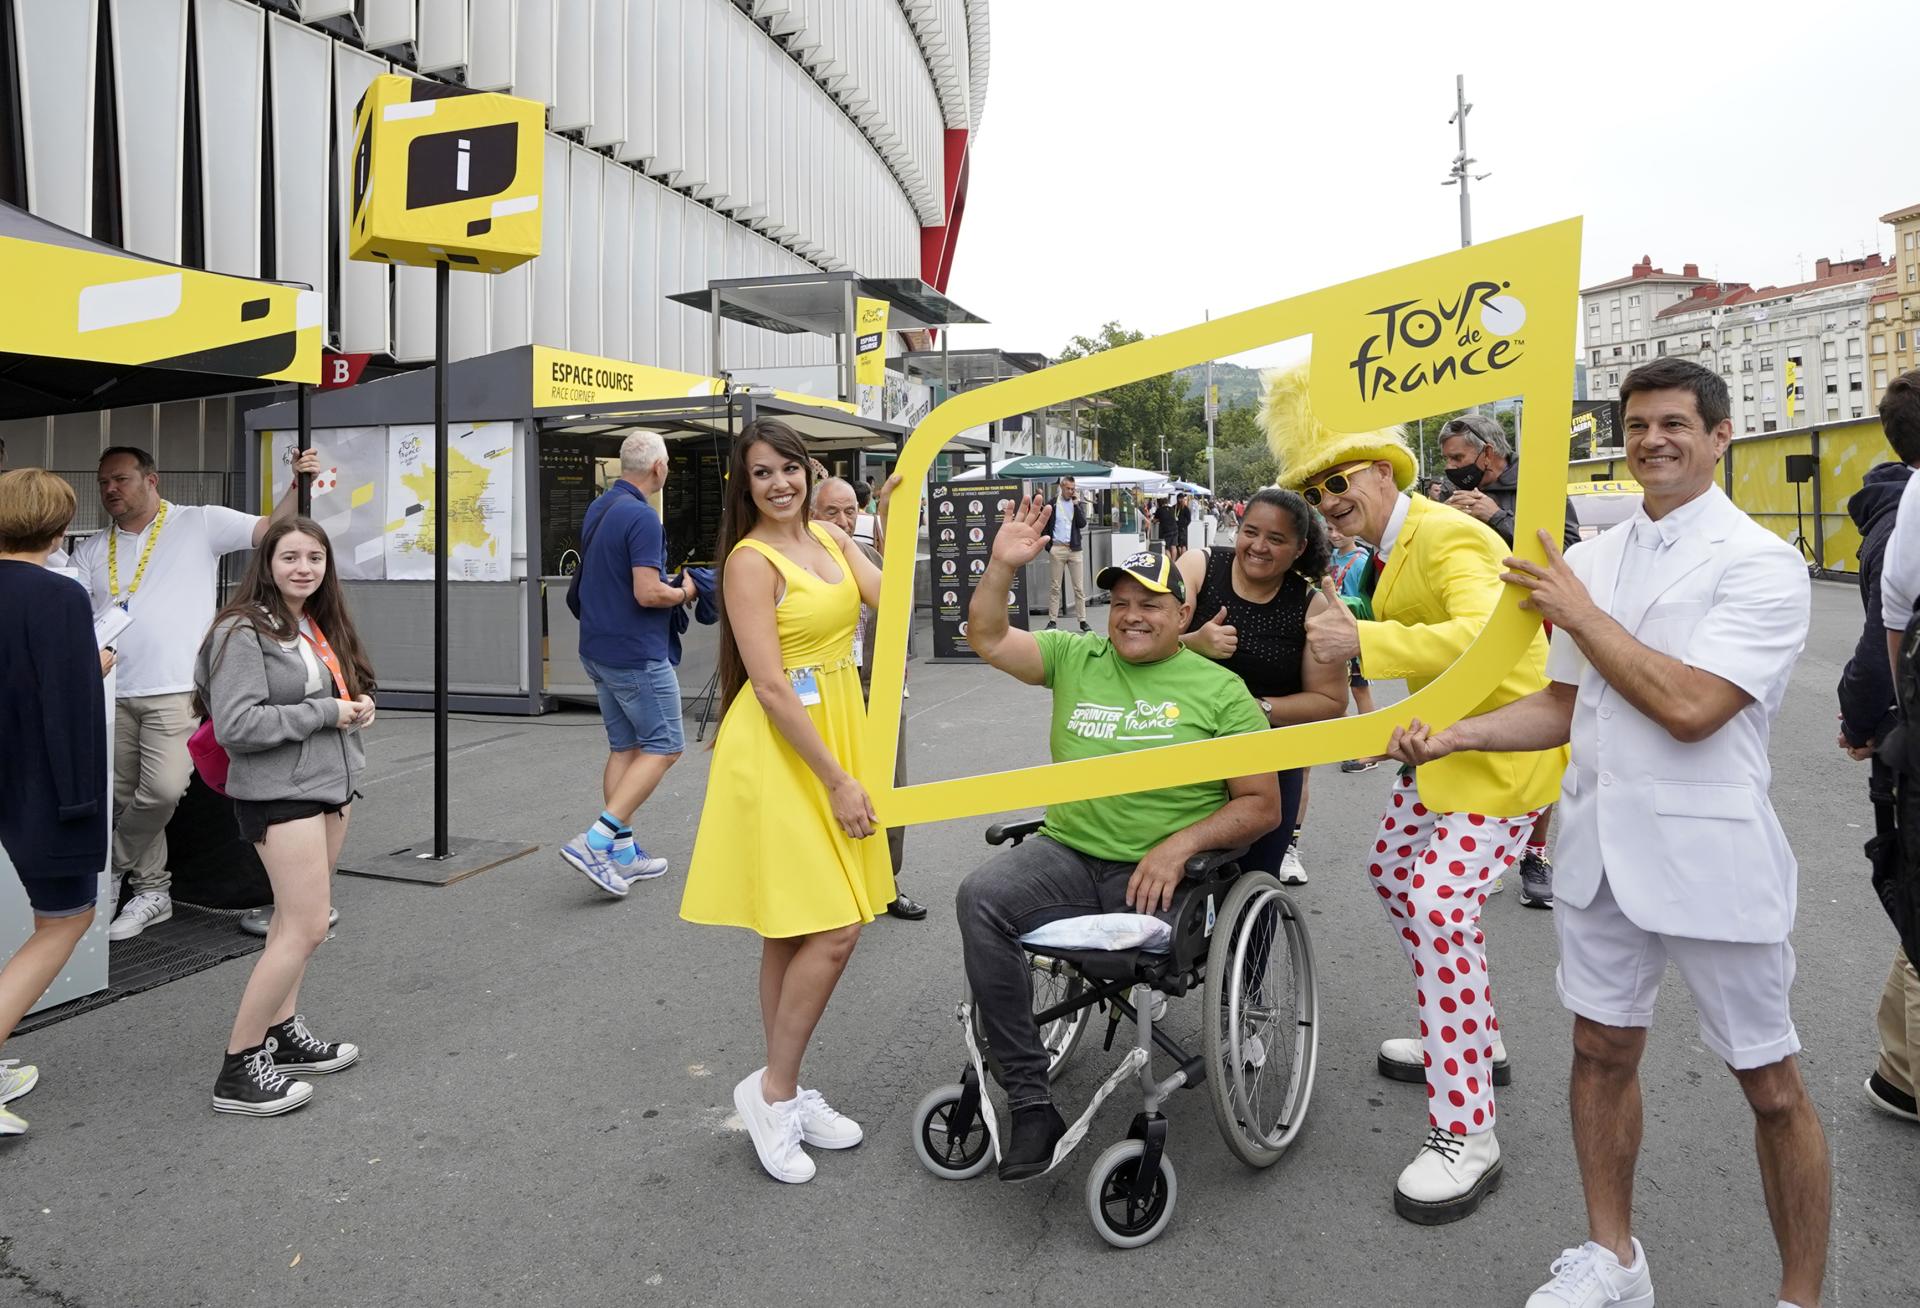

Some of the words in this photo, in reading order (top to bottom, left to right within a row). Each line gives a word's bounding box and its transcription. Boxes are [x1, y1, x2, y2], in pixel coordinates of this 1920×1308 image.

[456, 139, 470, 191] i
[1457, 324, 1482, 347] de
[333, 360, 350, 383] B
[552, 362, 593, 386] ESPACE
[595, 369, 633, 392] COURSE
[552, 386, 568, 400] RACE
[569, 388, 596, 403] CORNER
[1593, 483, 1629, 491] LCL
[1071, 709, 1123, 722] SPRINTER
[1135, 700, 1177, 717] TOUR
[1067, 720, 1078, 729] DU
[1077, 722, 1117, 739] TOUR
